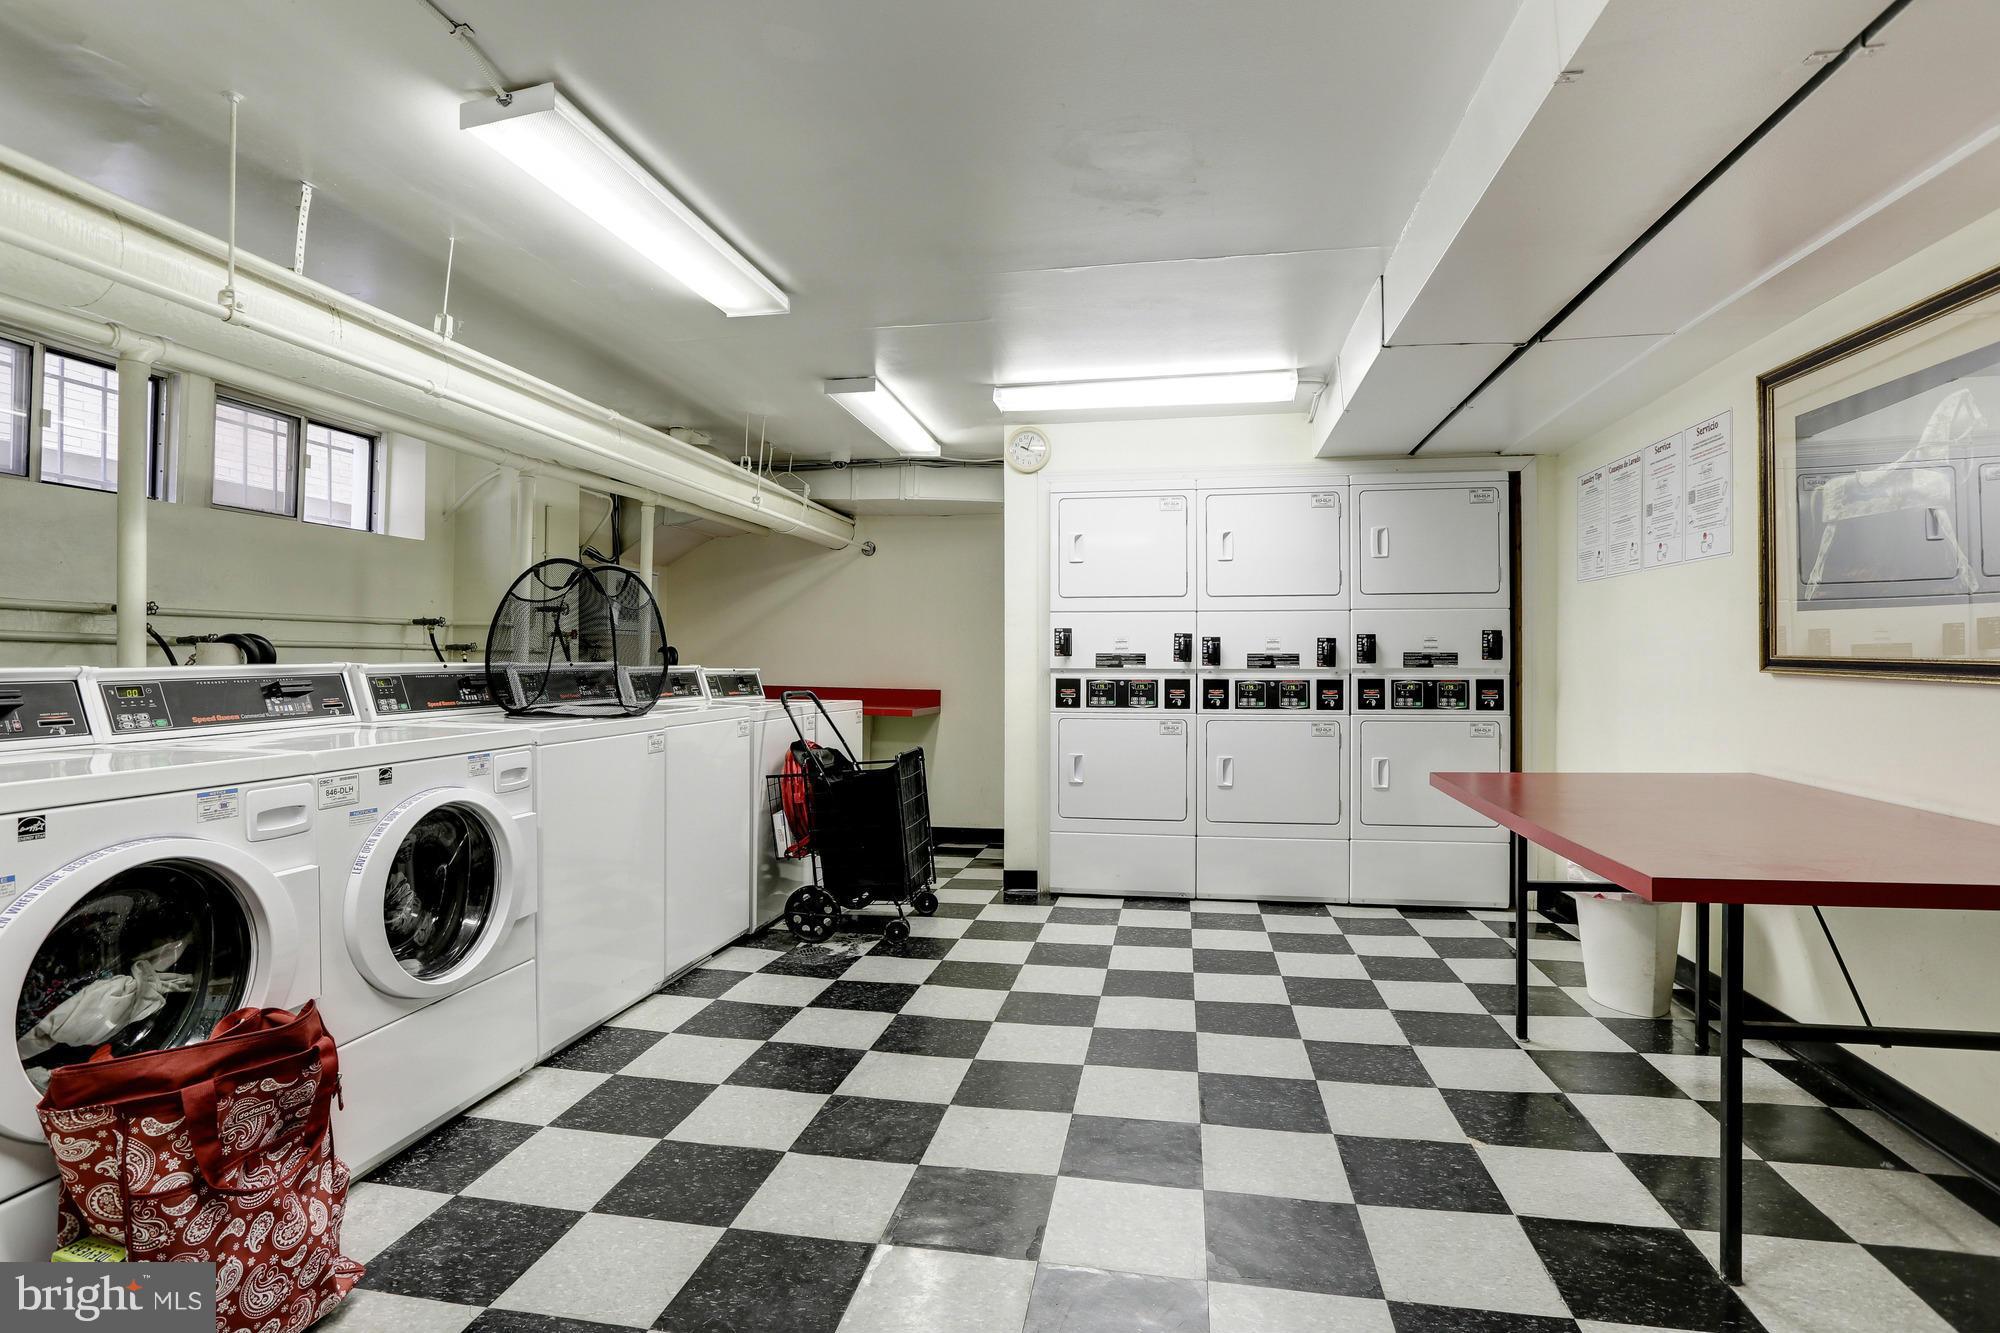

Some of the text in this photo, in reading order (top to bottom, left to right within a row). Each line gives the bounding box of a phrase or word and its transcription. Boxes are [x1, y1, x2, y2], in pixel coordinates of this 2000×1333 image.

[1696, 421, 1719, 436] Servicio
[1654, 442, 1671, 454] Service
[1581, 475, 1595, 486] Laundry
[192, 715, 215, 725] Speed
[216, 713, 240, 722] Queen
[325, 786, 354, 797] 846-DLH
[352, 854, 367, 875] LEAVE
[361, 838, 377, 855] OPEN
[373, 821, 390, 839] WHEN
[6, 892, 38, 915] WHEN
[34, 872, 62, 891] DONE
